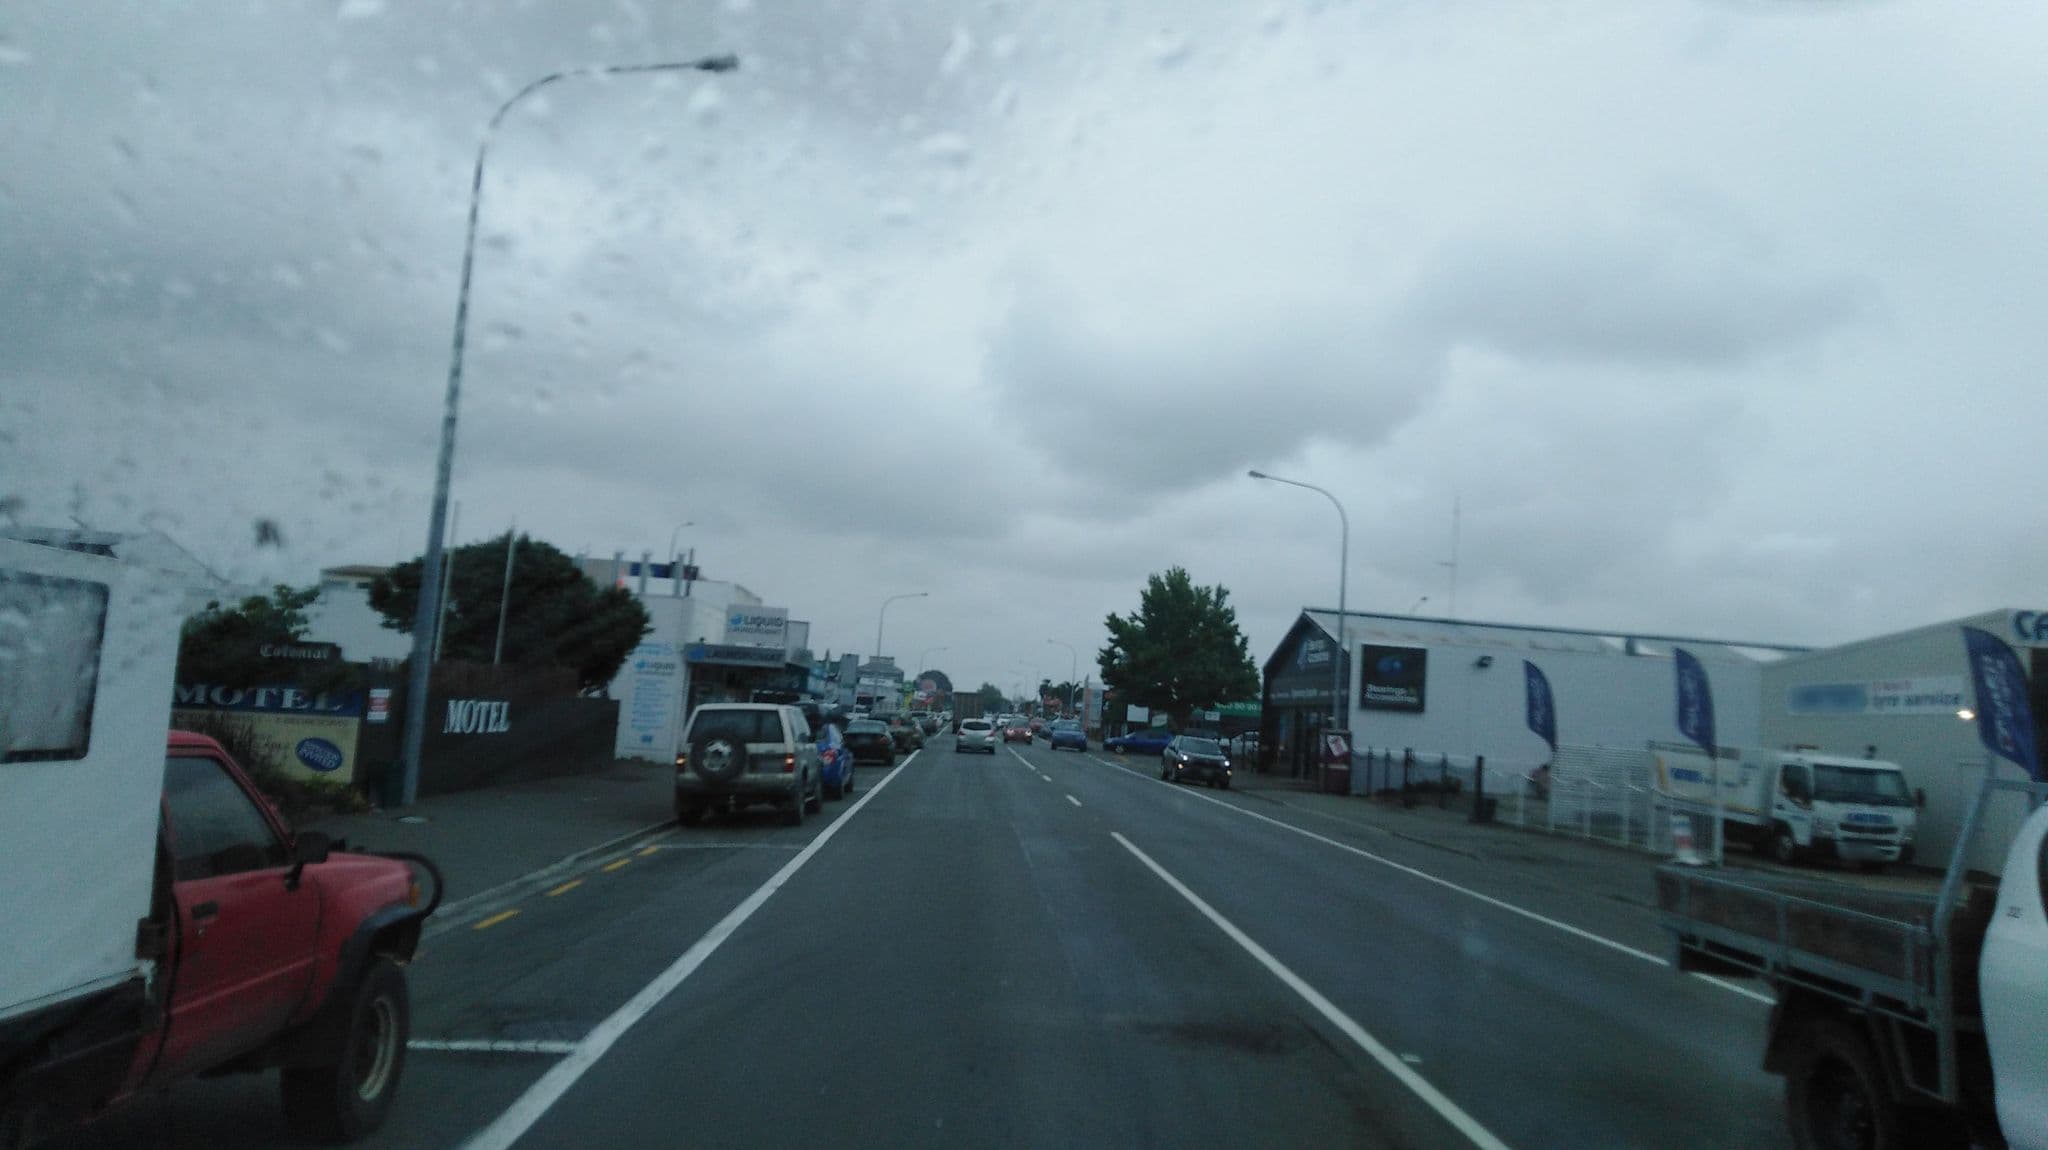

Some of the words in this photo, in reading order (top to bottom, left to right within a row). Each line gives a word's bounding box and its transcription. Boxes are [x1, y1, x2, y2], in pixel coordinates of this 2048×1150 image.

[259, 641, 330, 660] Colonial
[174, 682, 344, 712] MOTEL
[442, 699, 511, 734] MOTEL
